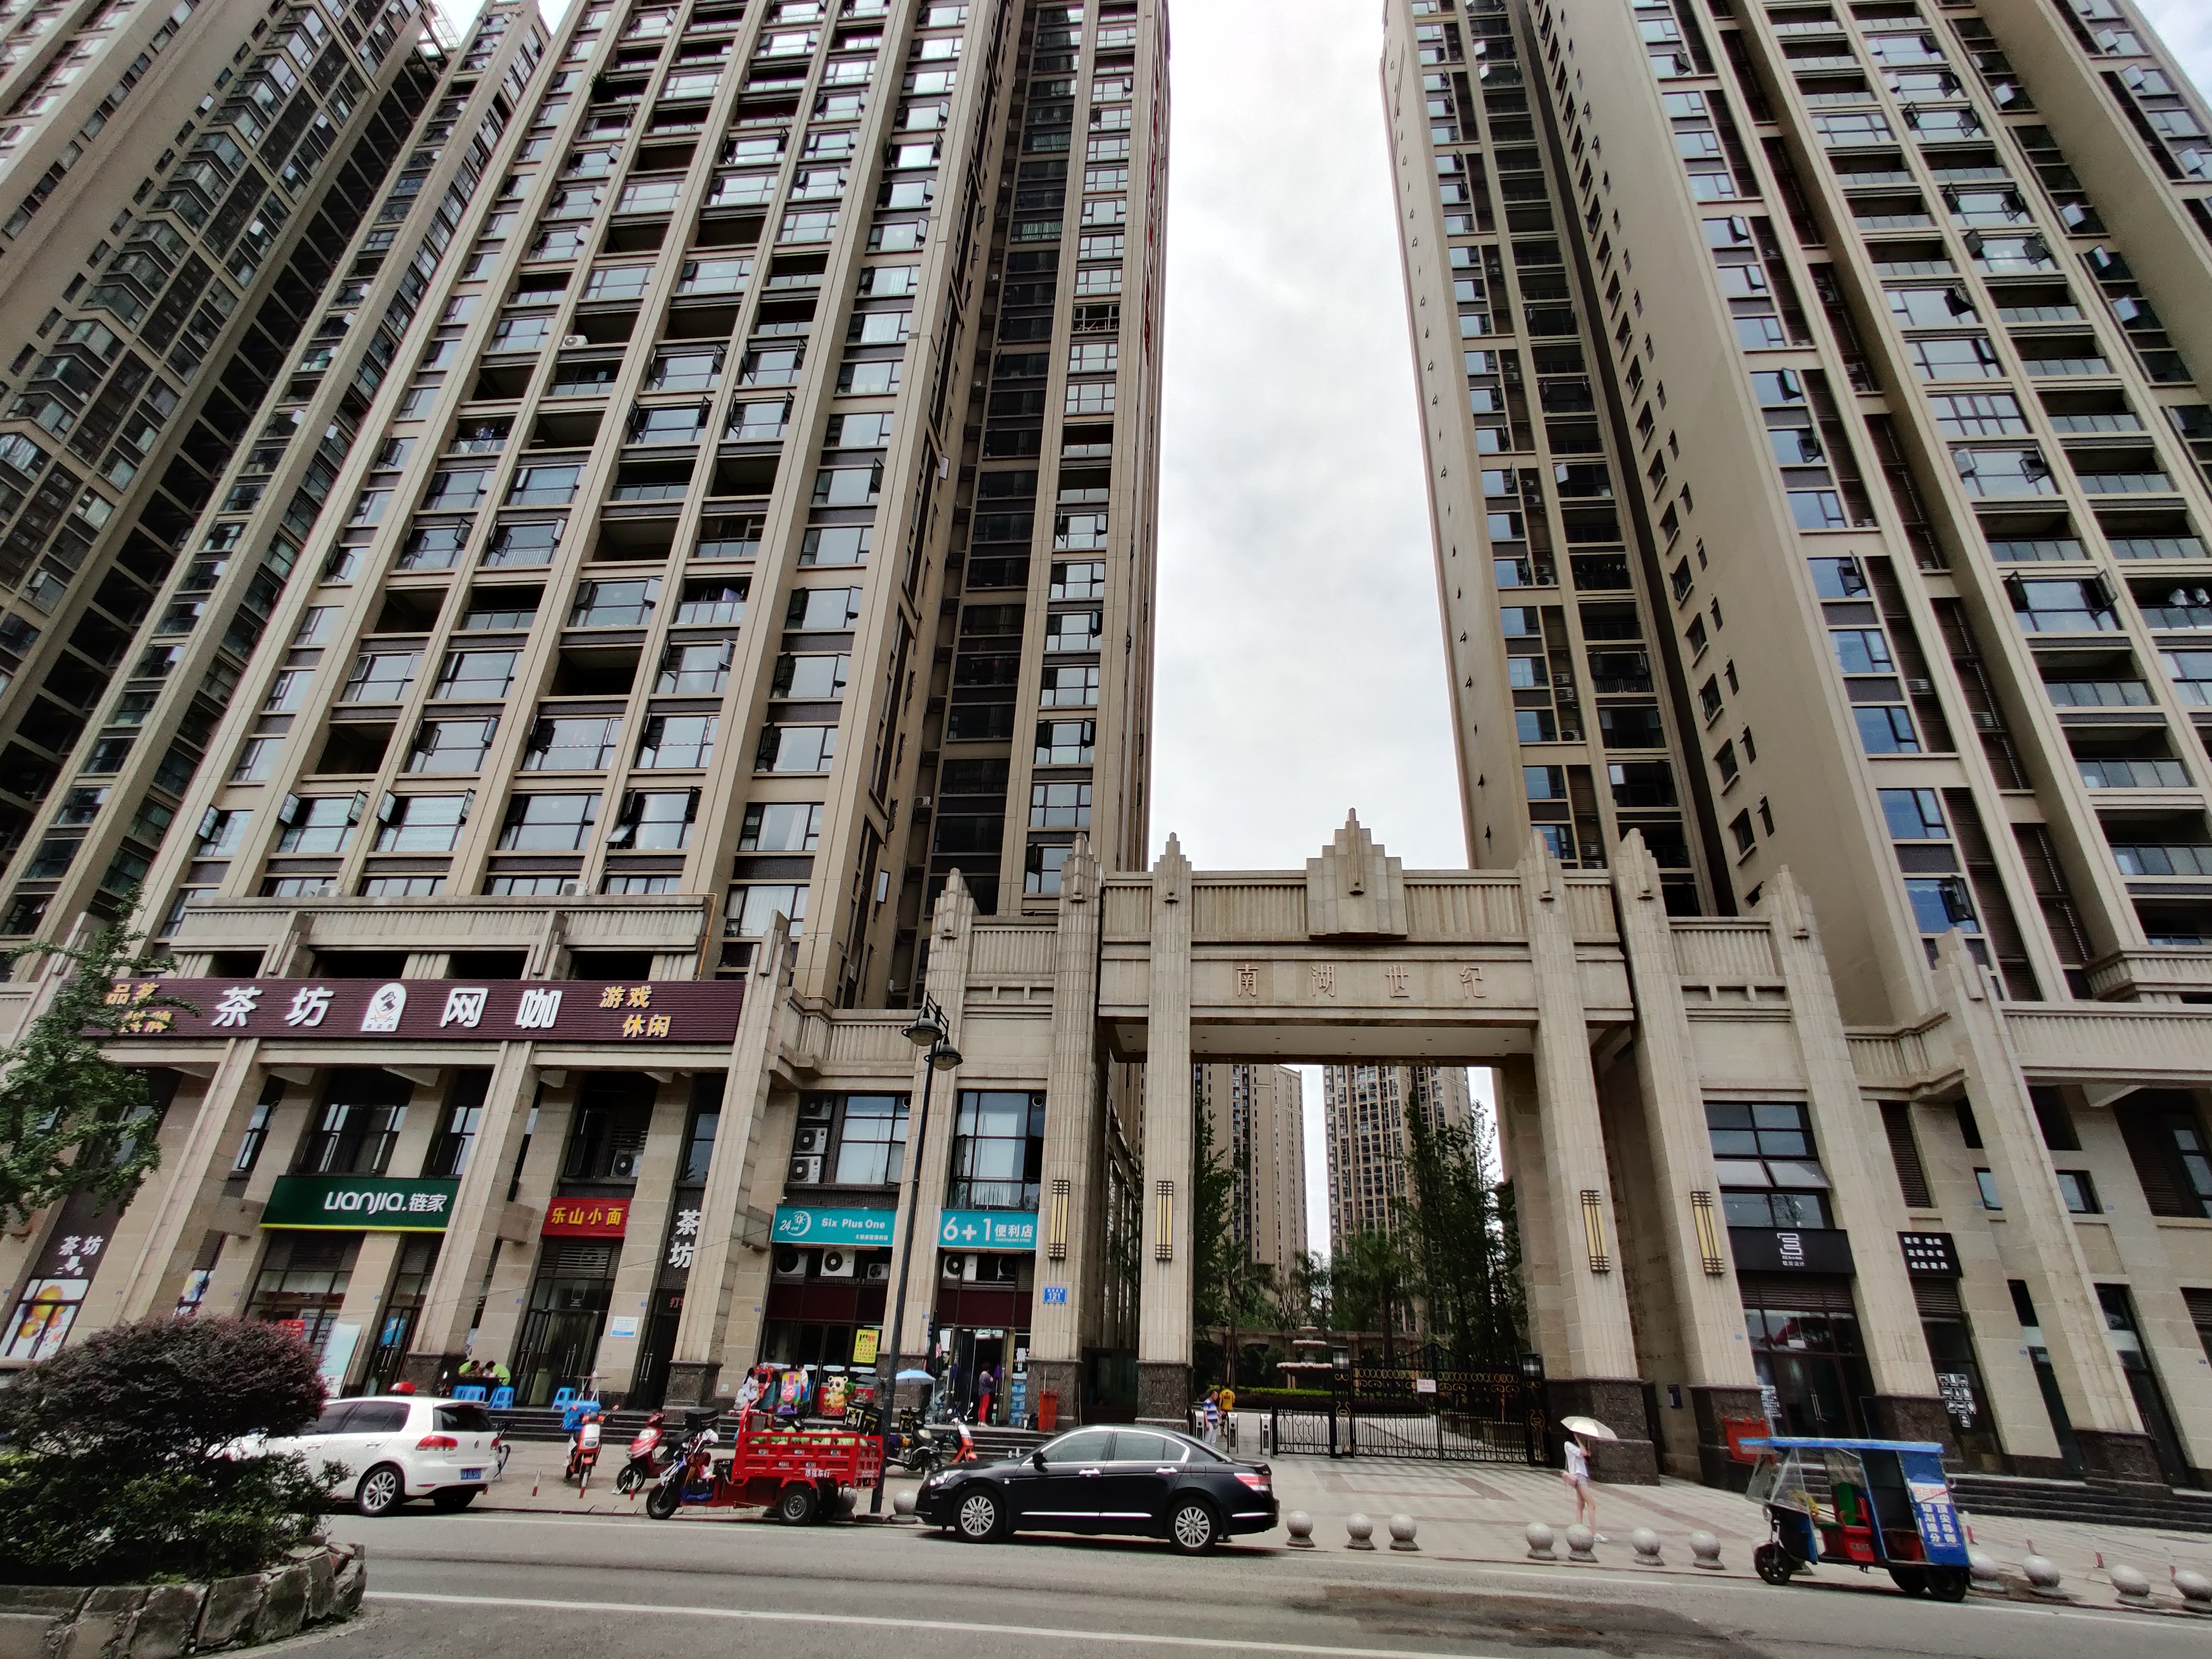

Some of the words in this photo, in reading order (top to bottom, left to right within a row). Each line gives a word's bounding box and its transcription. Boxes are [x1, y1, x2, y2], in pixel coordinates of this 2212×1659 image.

[1236, 964, 1486, 998] 南湖世纪
[211, 986, 334, 1027] 茶坊
[440, 988, 563, 1029] 网咖
[599, 985, 652, 1009] 游戏
[622, 1014, 671, 1038] 休闲
[409, 1193, 447, 1212] 链家
[551, 1207, 624, 1226] 乐山小面
[779, 1220, 792, 1231] 24
[821, 1218, 837, 1227] Six
[842, 1218, 863, 1228] Plus
[865, 1219, 885, 1229] One
[943, 1216, 991, 1241] 6+1
[995, 1224, 1034, 1238] 便利店
[59, 1236, 104, 1255] 茶坊
[668, 1209, 701, 1268] 茶坊
